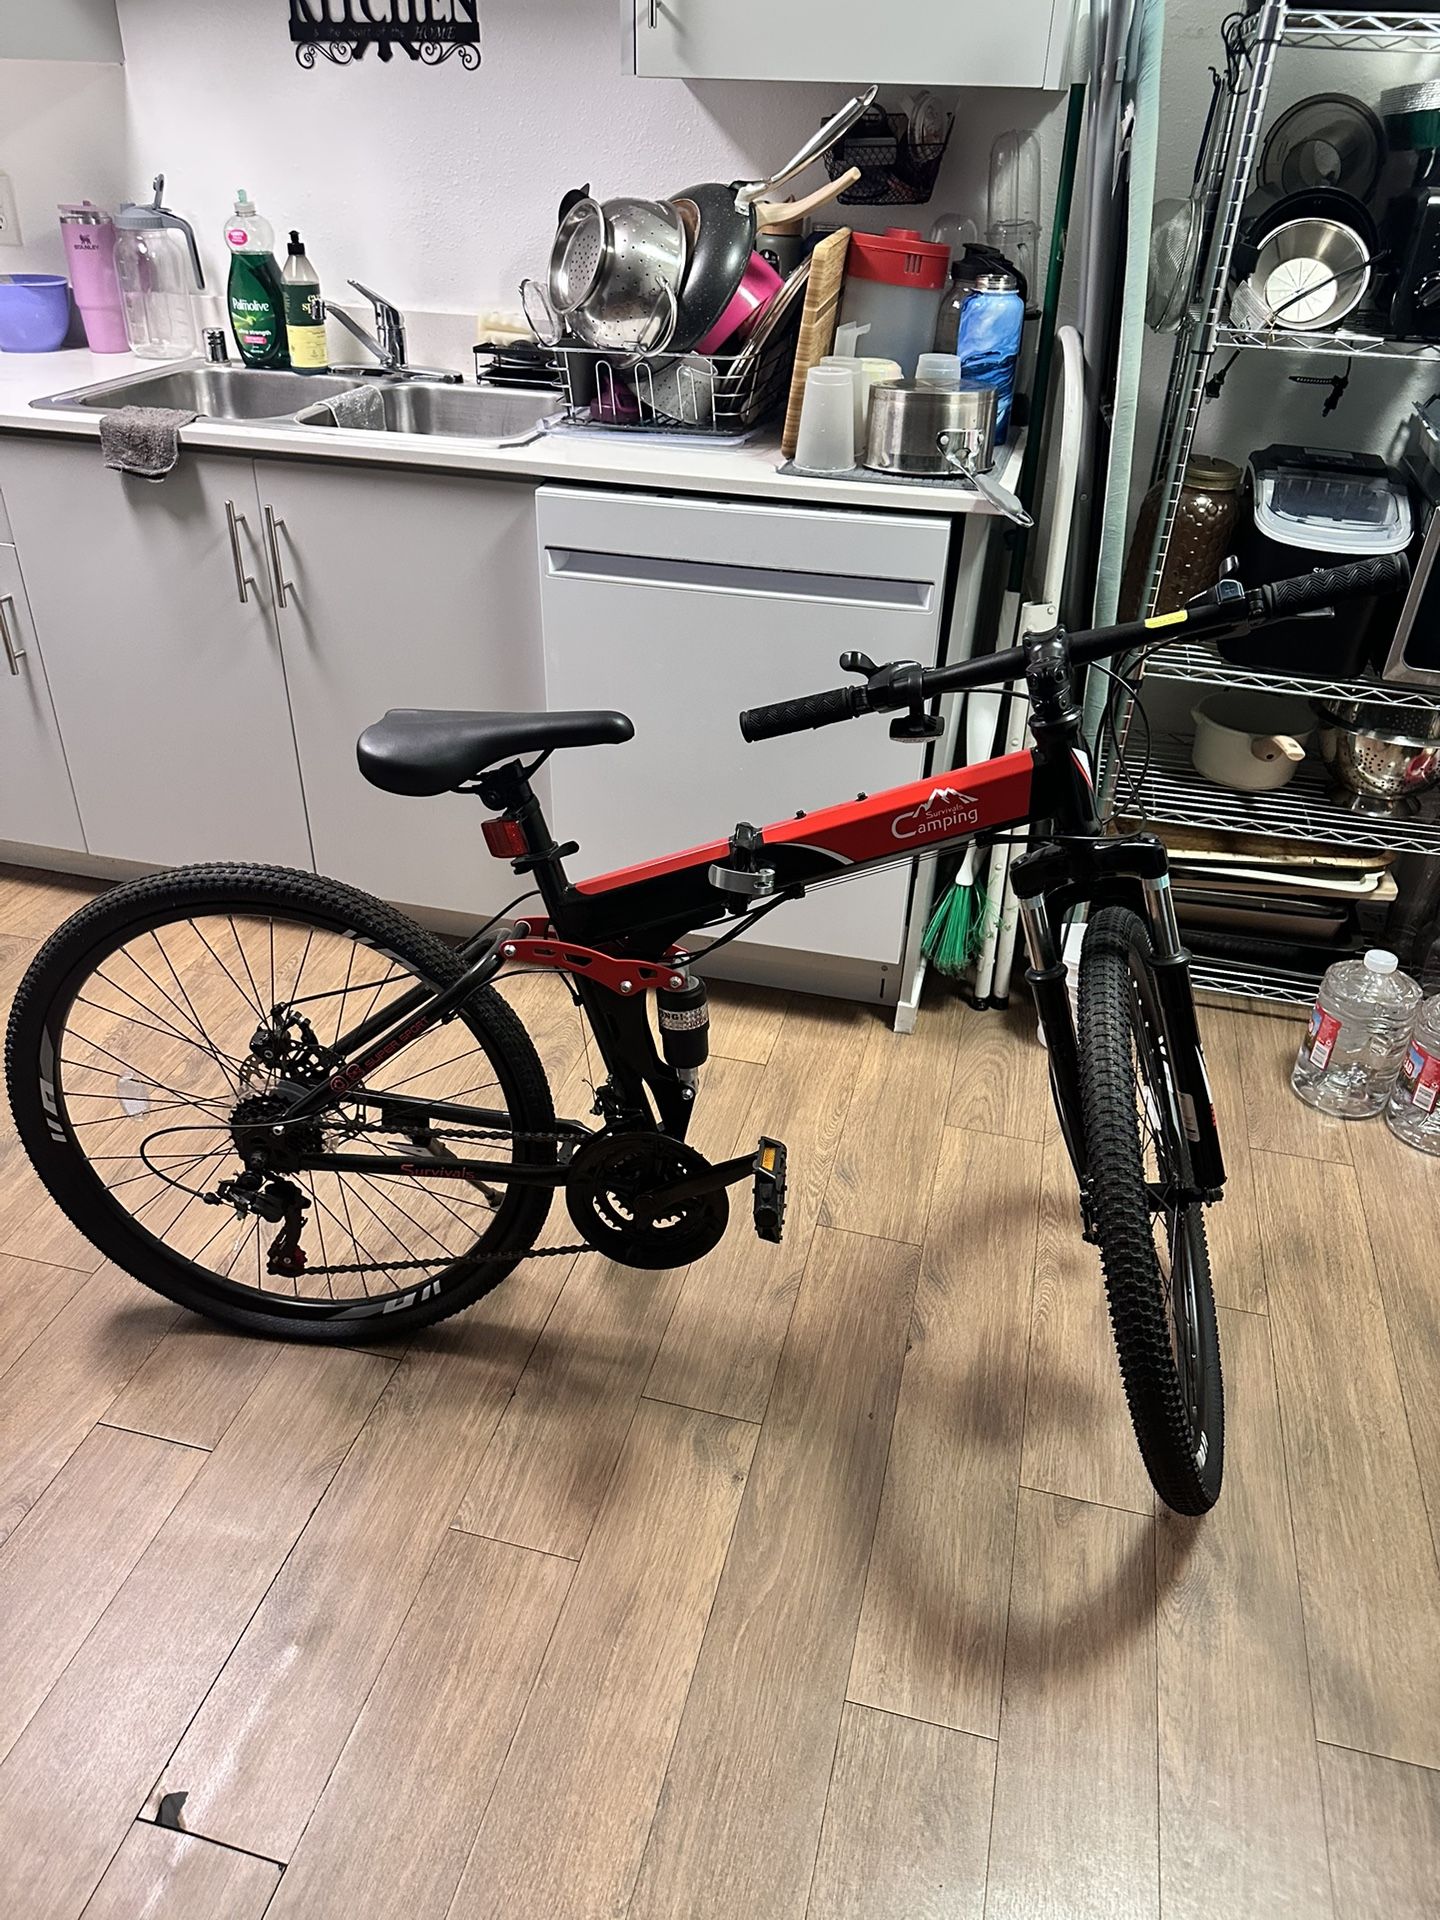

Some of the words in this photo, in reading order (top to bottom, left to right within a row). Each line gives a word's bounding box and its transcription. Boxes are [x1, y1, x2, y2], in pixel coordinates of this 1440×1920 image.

[414, 26, 457, 40] HOME
[231, 297, 270, 312] Palmolive
[925, 803, 964, 819] Survivals
[891, 808, 978, 839] Camping
[364, 1039, 398, 1069] SUPER
[399, 1016, 430, 1042] SPORT
[400, 1163, 477, 1179] Survivals
